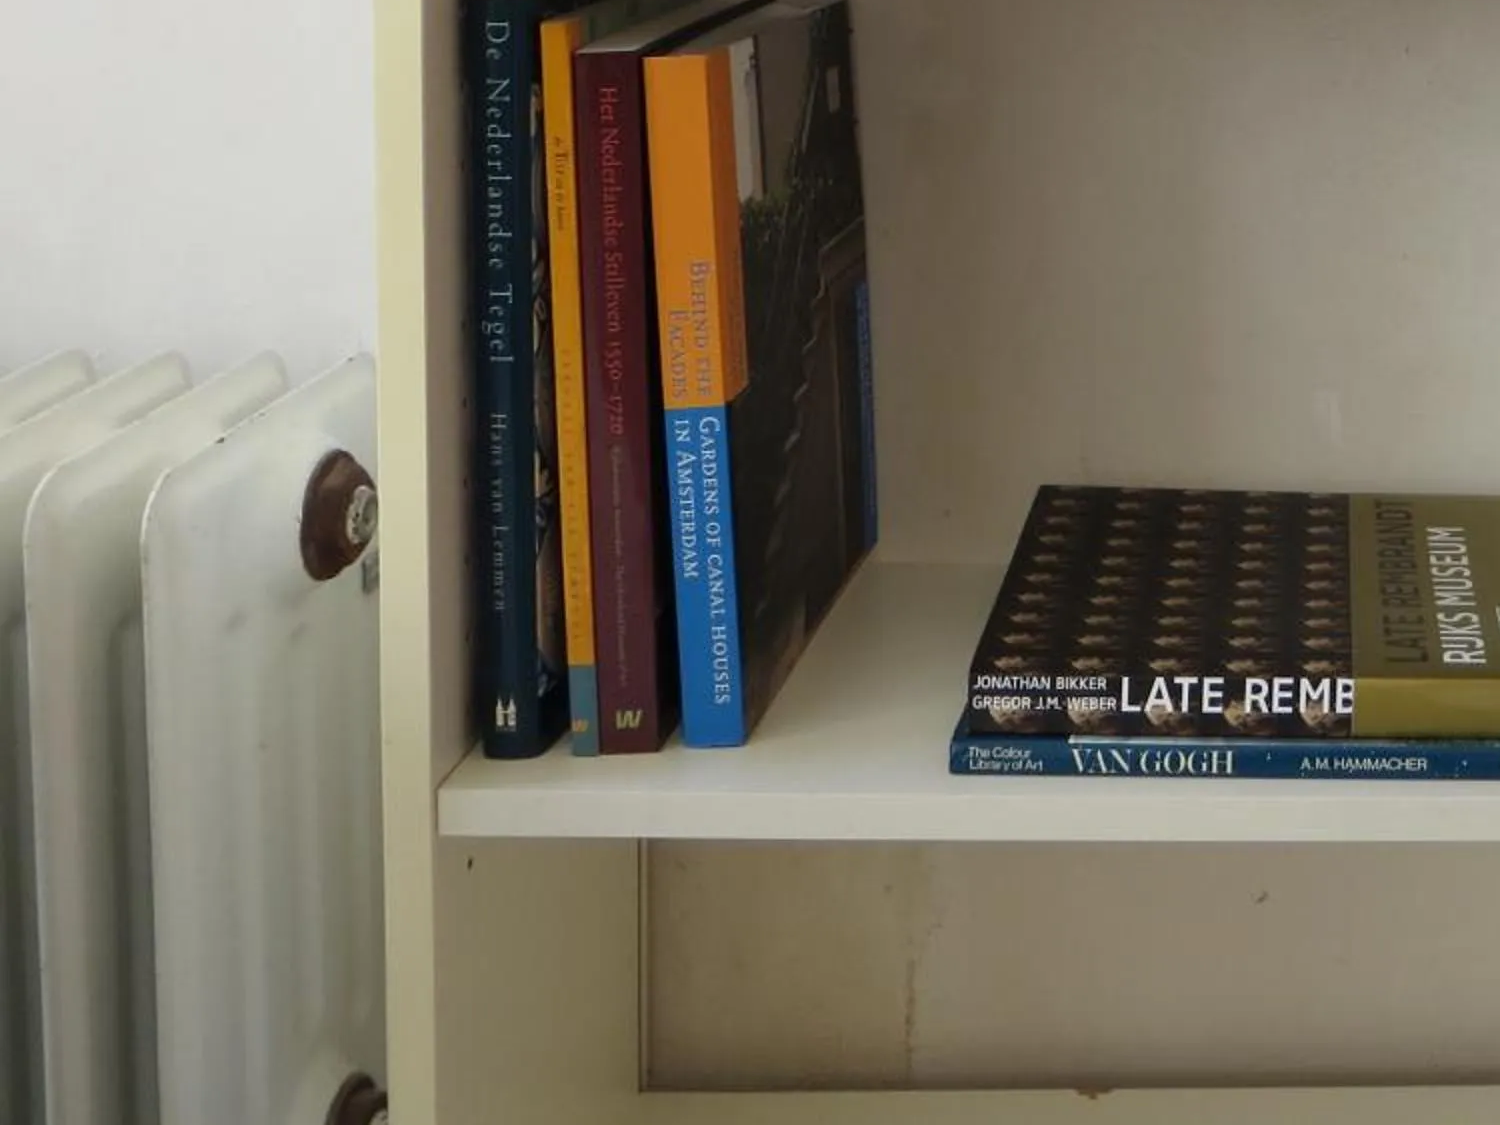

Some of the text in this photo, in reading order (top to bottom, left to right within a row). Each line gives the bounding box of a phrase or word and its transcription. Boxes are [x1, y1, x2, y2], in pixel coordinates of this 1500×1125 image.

[483, 20, 513, 363] De Nederlandse Tegel
[599, 88, 624, 333] Het Nederlandse Stilleven
[688, 260, 713, 397] BEHIND THE
[492, 478, 506, 513] van
[674, 419, 700, 579] IN AMSTERDAM
[491, 526, 510, 611] Lemmen
[699, 416, 731, 705] GARDENS OF CANAL HOUSES
[1374, 499, 1429, 663] LATE REMBRANDT
[1426, 526, 1487, 664] RIJKS MUSEUM
[972, 676, 1107, 691] JONATHAN BIKKER
[972, 696, 1031, 711] GREGOR
[1067, 697, 1117, 711] WEBER
[1121, 677, 1354, 714] LATE REMB
[968, 746, 1032, 758] The Colour
[968, 758, 1044, 772] Library of Art
[1070, 748, 1234, 775] VAN GOGH
[1300, 757, 1428, 772] A.M. HAMMACHER
